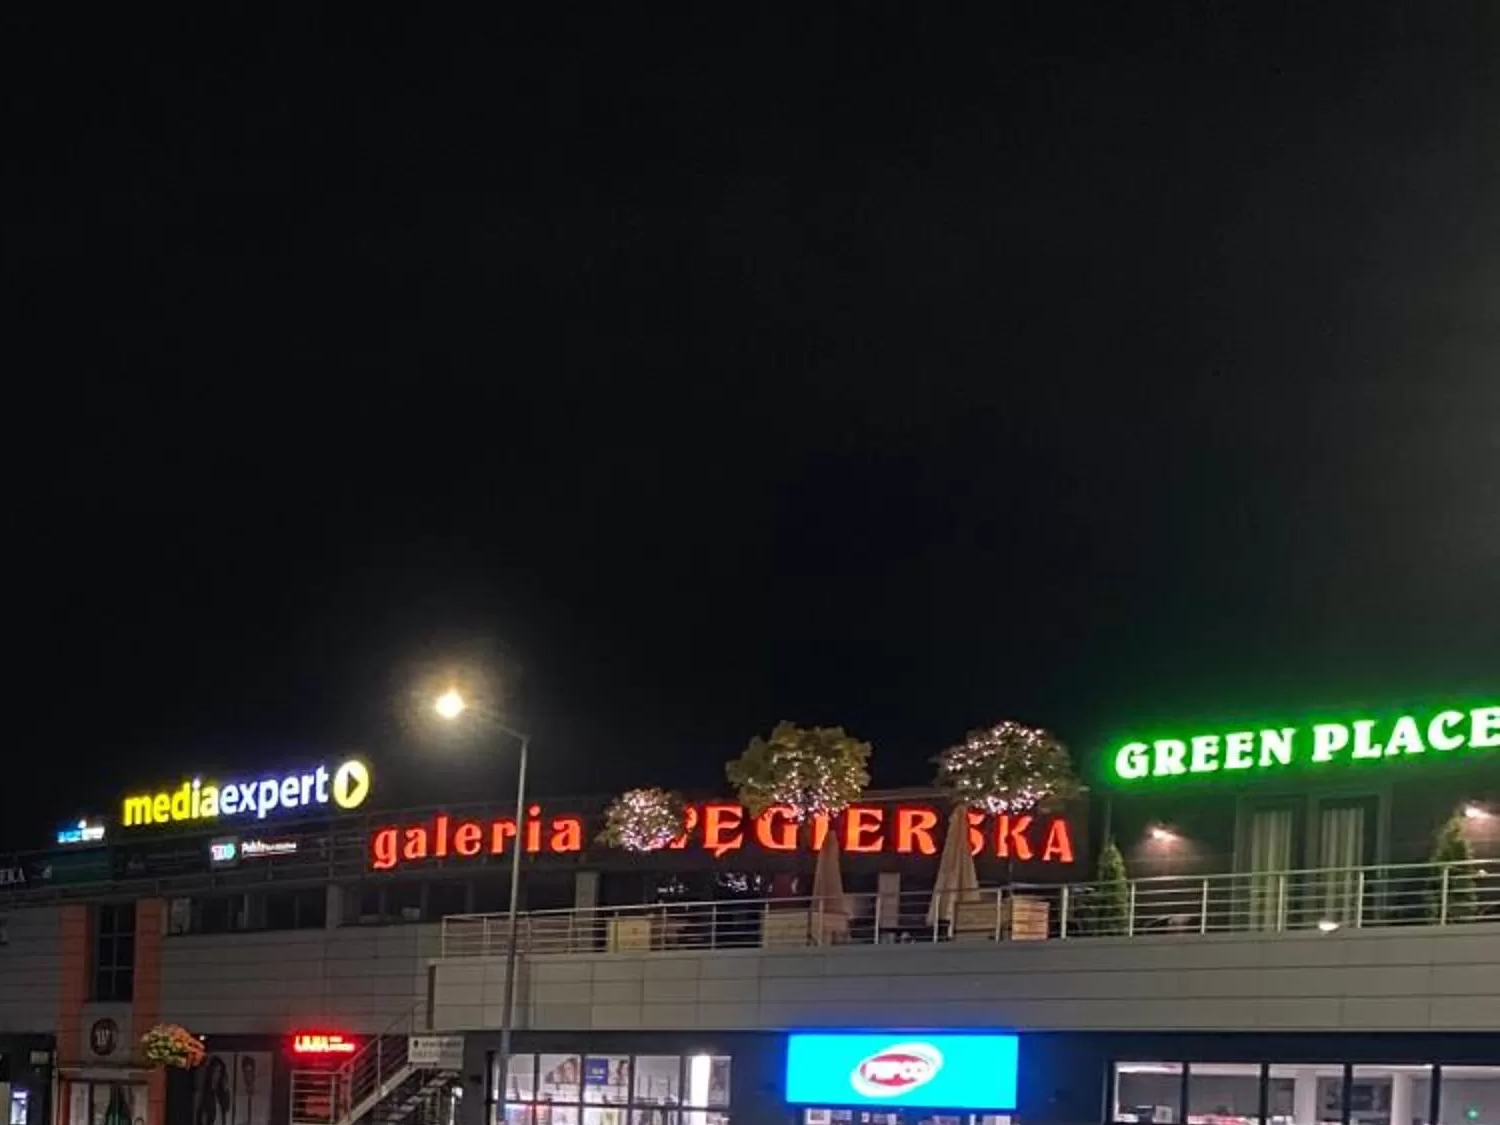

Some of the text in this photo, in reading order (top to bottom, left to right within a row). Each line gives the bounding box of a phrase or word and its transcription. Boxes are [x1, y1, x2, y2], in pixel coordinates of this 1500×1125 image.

[1114, 706, 1500, 779] GREEN PLACE
[123, 764, 330, 828] mediaexpert
[372, 802, 1075, 869] galeria ĘGIERSKA
